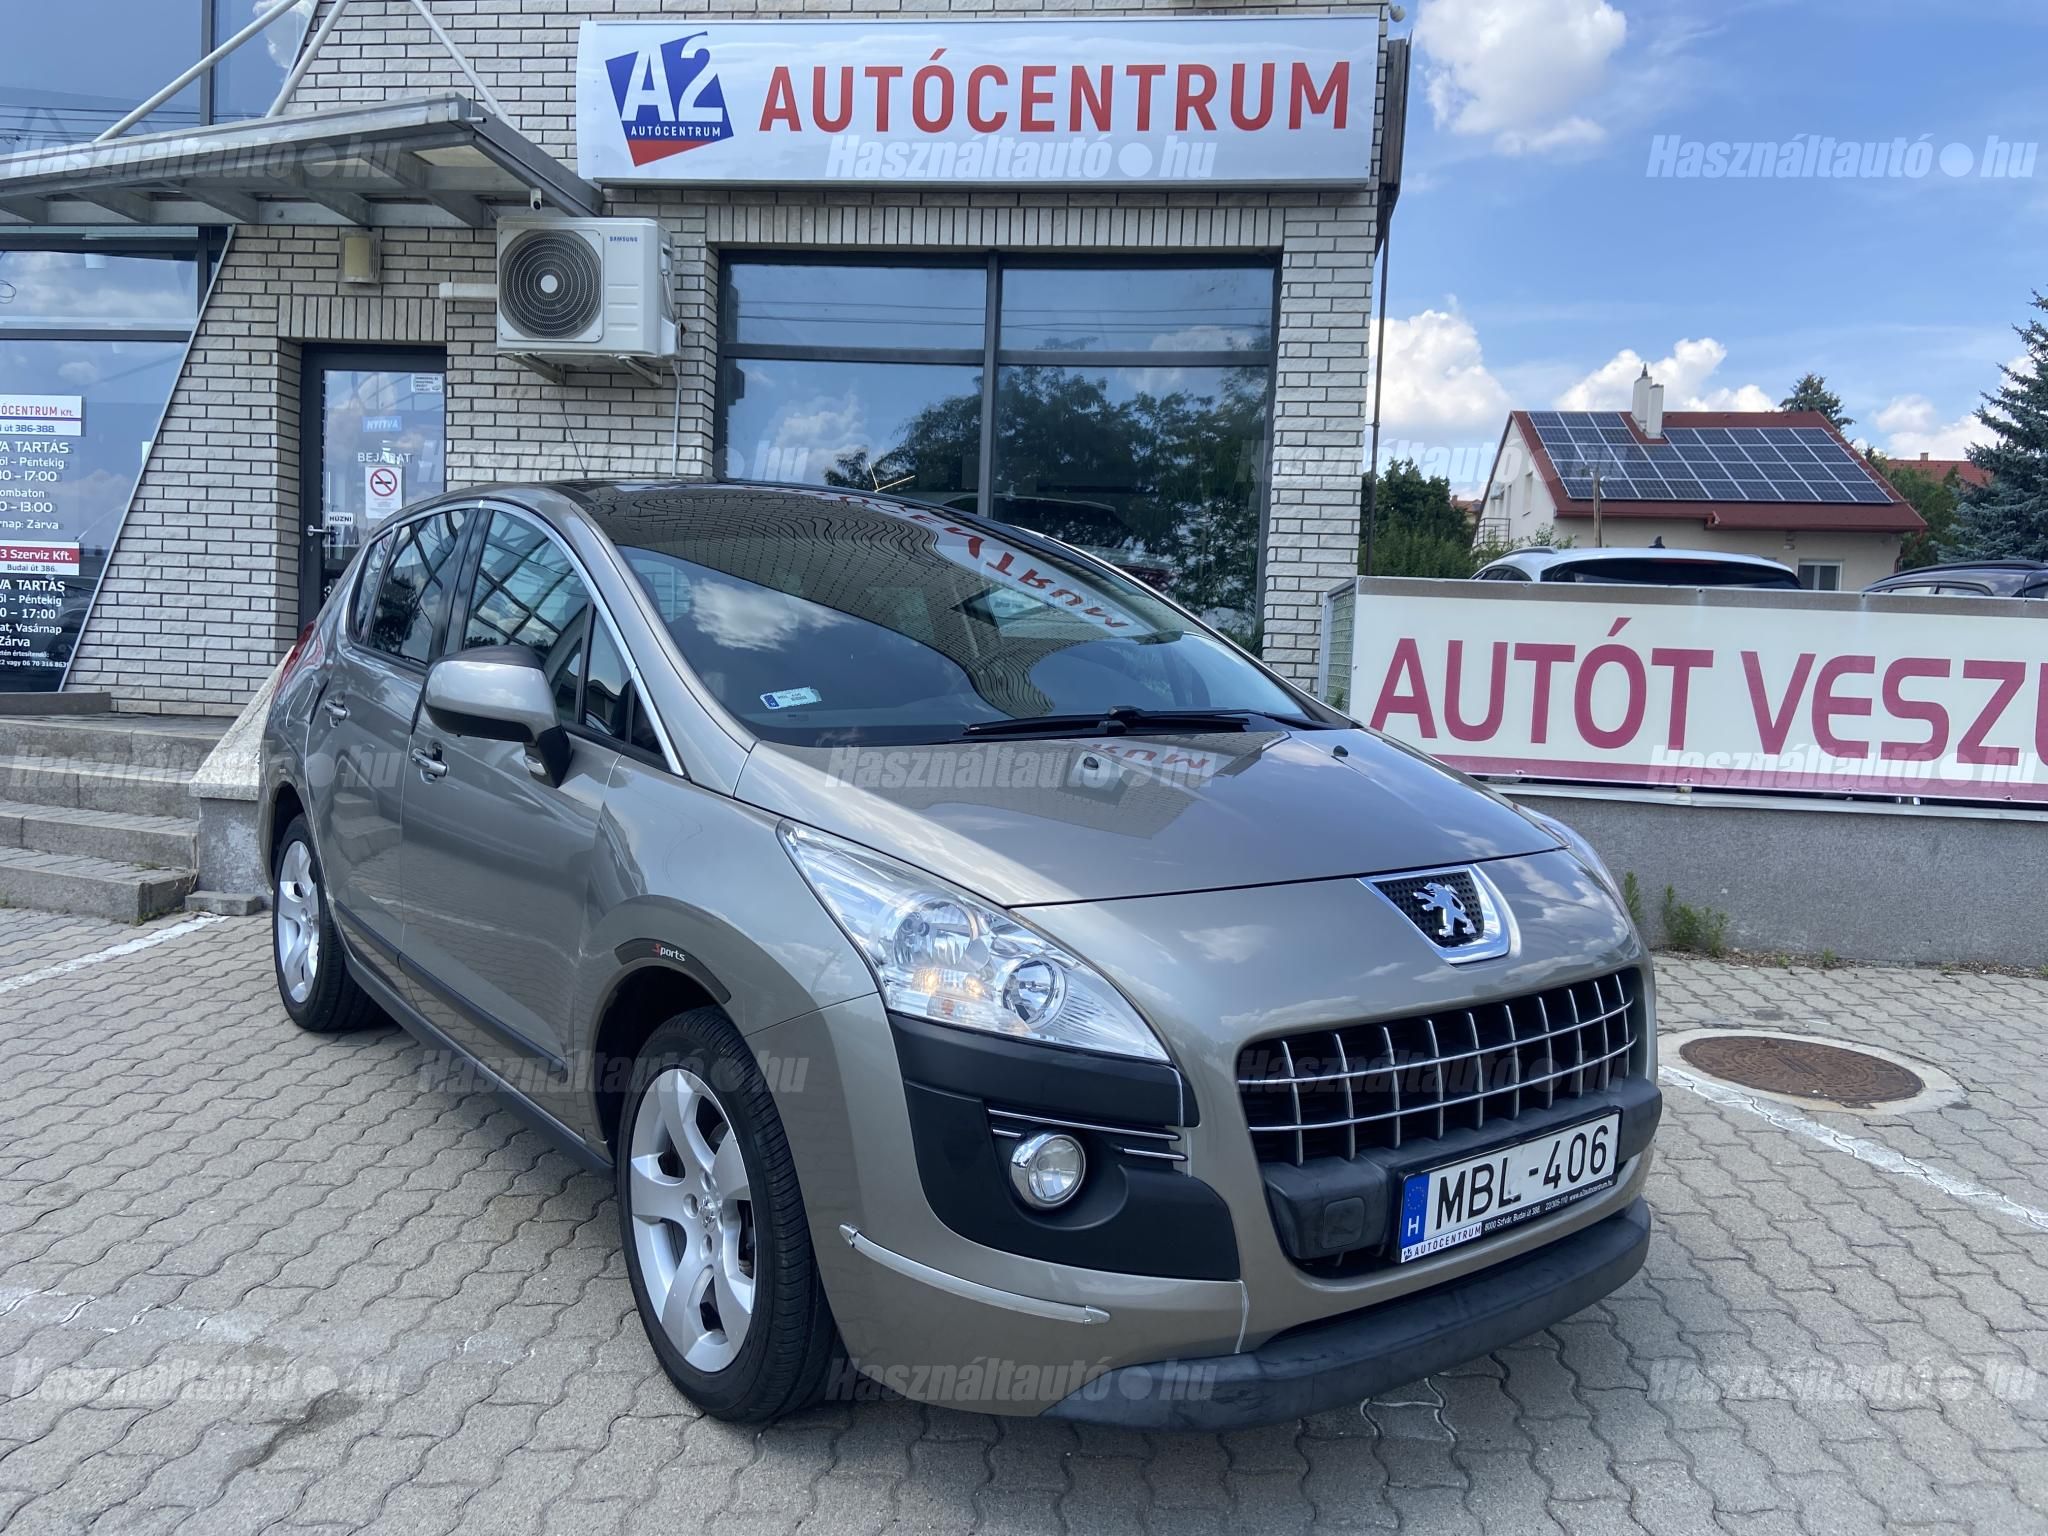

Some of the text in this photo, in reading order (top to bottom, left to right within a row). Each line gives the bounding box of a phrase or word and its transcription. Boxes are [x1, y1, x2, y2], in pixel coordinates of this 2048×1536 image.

[620, 31, 724, 122] A2
[760, 48, 1350, 133] AUTÓCENTRUM
[631, 124, 721, 137] AUTÓCENTRUM
[15, 439, 69, 453] TARTÁS
[24, 470, 58, 482] 17:00
[20, 501, 53, 513] 13:00
[10, 549, 50, 560] Szerviz
[53, 551, 72, 561] Kft.
[31, 563, 38, 571] út
[16, 579, 66, 592] TARTÁS
[19, 594, 62, 607] Péntekig
[22, 608, 56, 619] 17:00
[16, 623, 62, 635] Vasárnap
[0, 635, 31, 647] Zárva
[1369, 617, 2048, 767] AUTÓT VESZ
[1434, 1124, 1609, 1231] MBL-406
[1407, 1214, 1420, 1238] H
